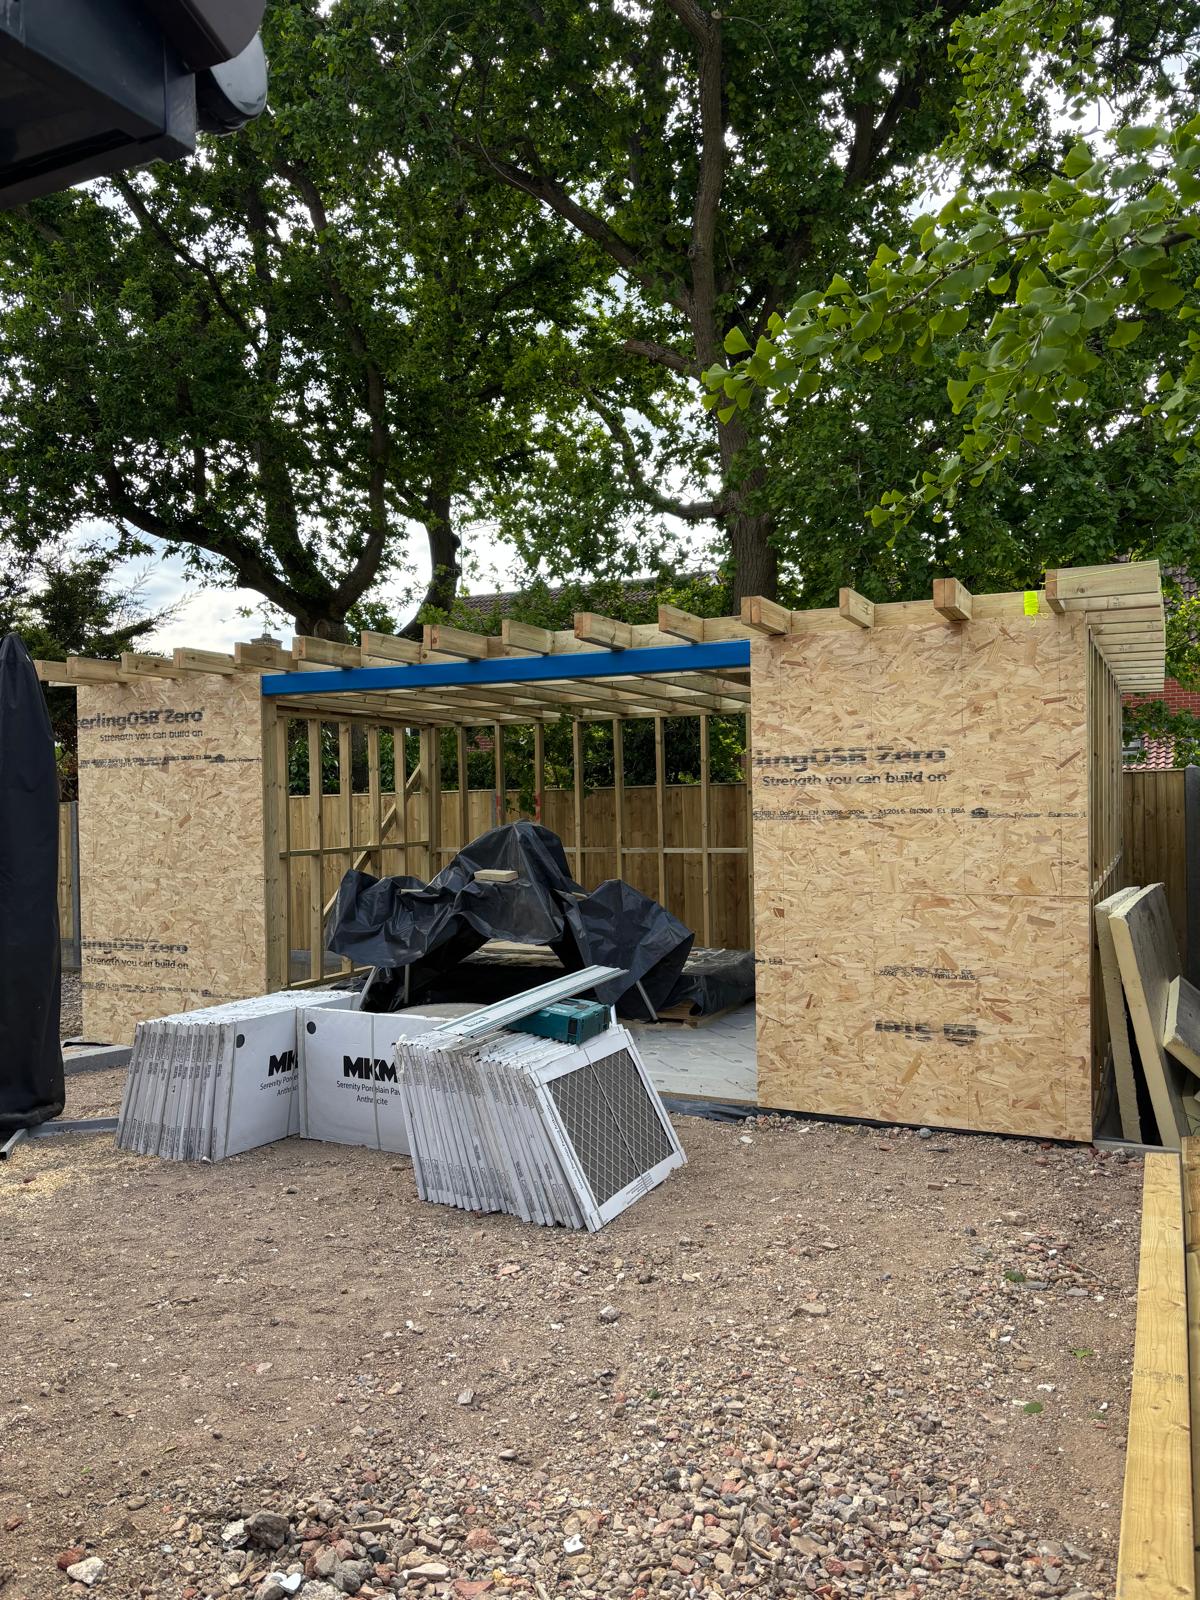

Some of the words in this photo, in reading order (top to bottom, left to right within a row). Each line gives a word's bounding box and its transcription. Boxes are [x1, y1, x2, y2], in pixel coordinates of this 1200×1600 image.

[164, 709, 204, 724] Zero
[135, 732, 151, 741] you
[153, 731, 168, 740] can
[192, 729, 203, 737] on
[762, 775, 822, 786] Strength
[825, 775, 852, 785] you
[856, 774, 881, 783] can
[886, 771, 924, 783] build
[927, 773, 948, 782] on
[121, 959, 137, 968] you
[155, 959, 176, 968] build
[177, 962, 189, 970] on
[343, 1055, 398, 1083] MKM
[260, 1078, 281, 1091] Serenity
[336, 1080, 361, 1093] Serenity
